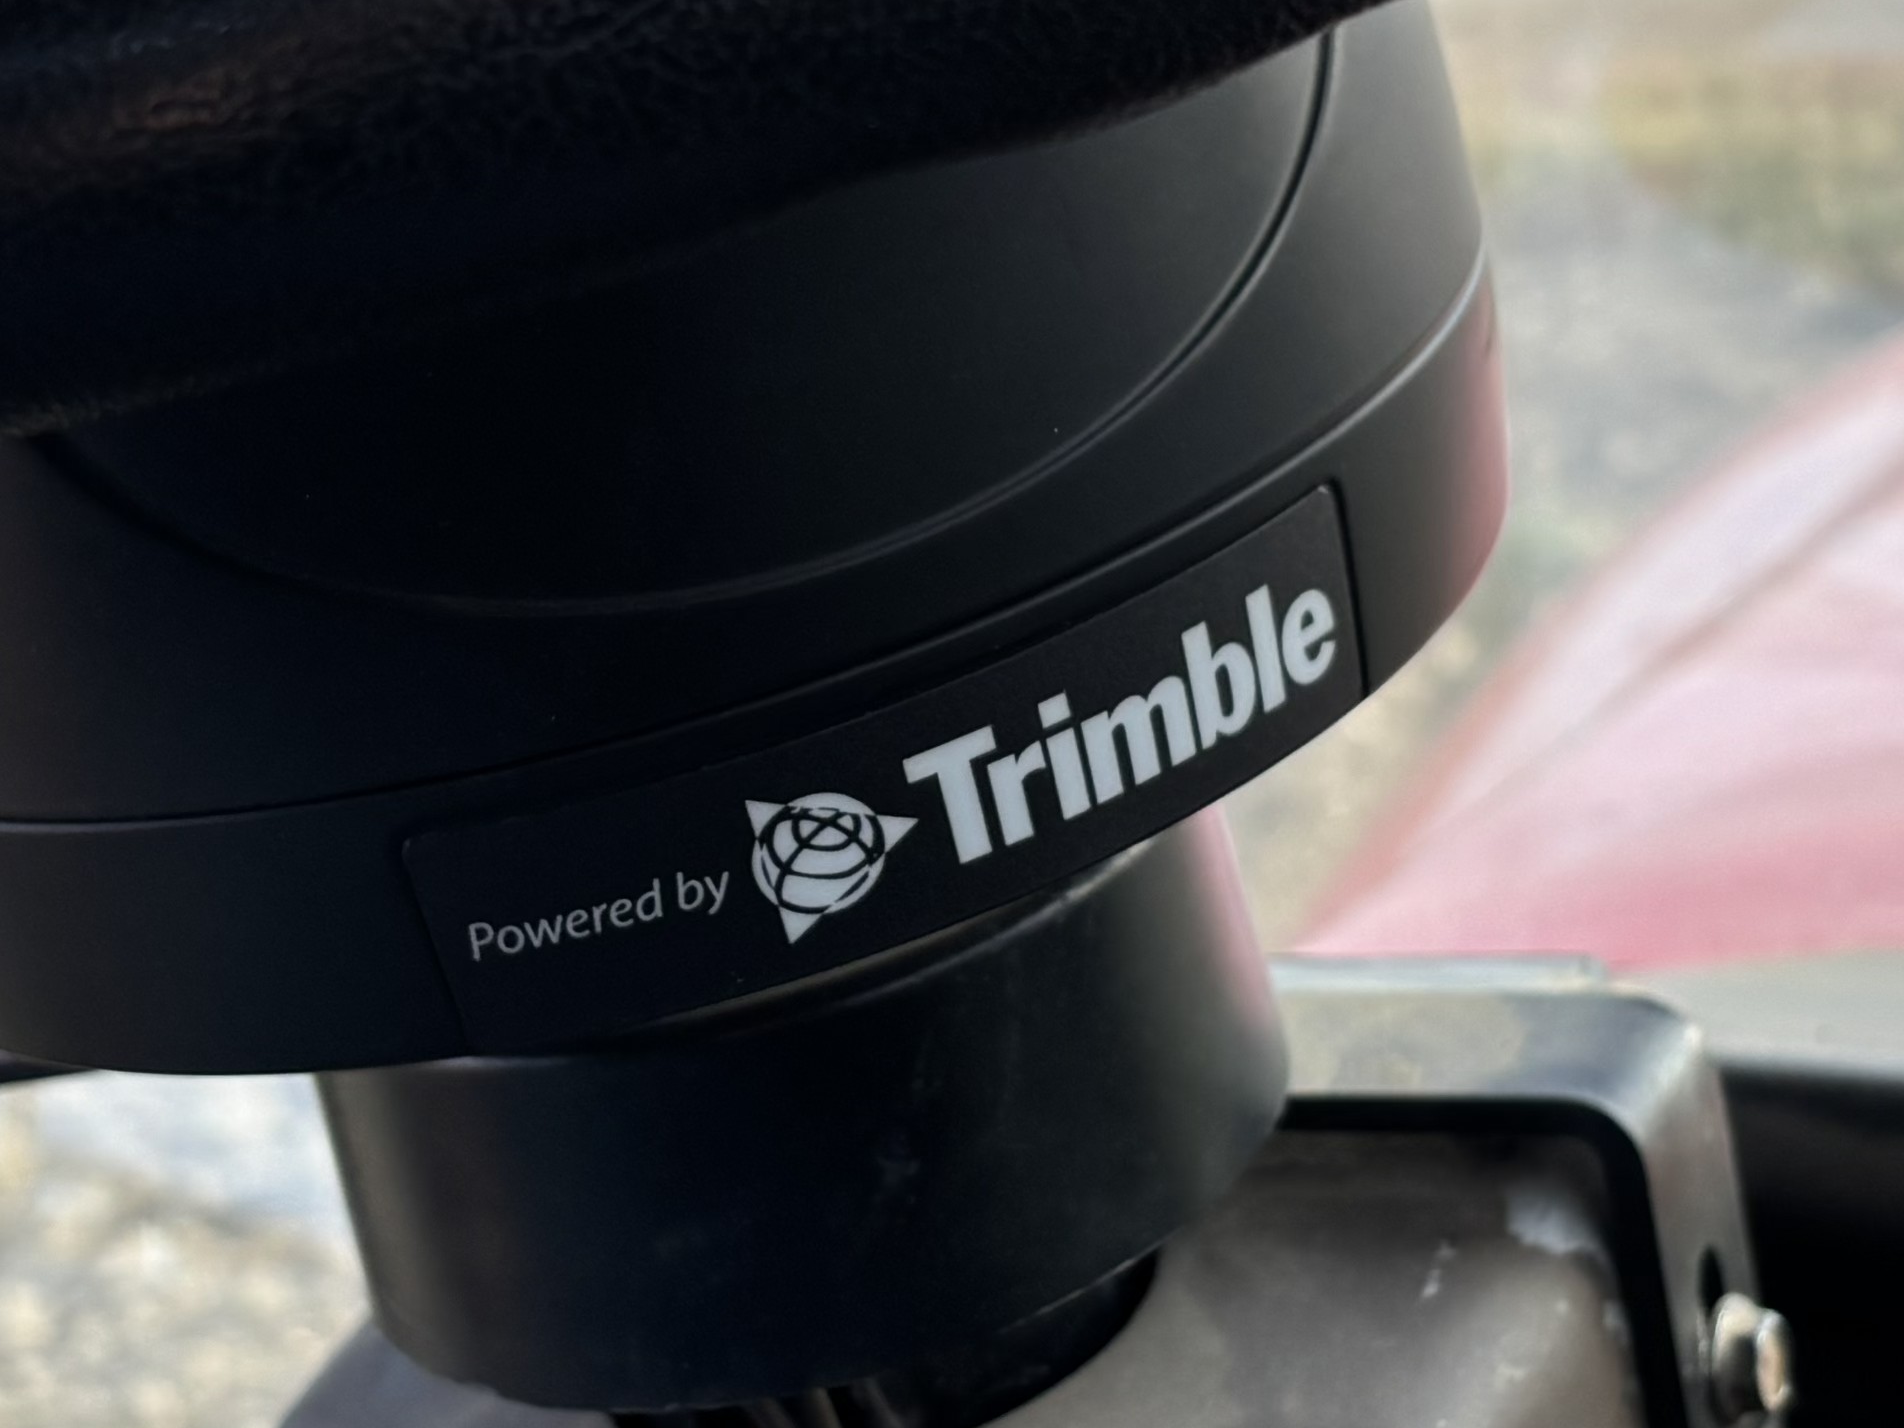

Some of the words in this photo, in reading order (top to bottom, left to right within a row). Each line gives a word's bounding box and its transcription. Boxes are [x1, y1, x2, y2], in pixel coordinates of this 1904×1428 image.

[468, 877, 664, 961] Powered
[676, 871, 730, 915] by
[902, 584, 1338, 864] Trimble
